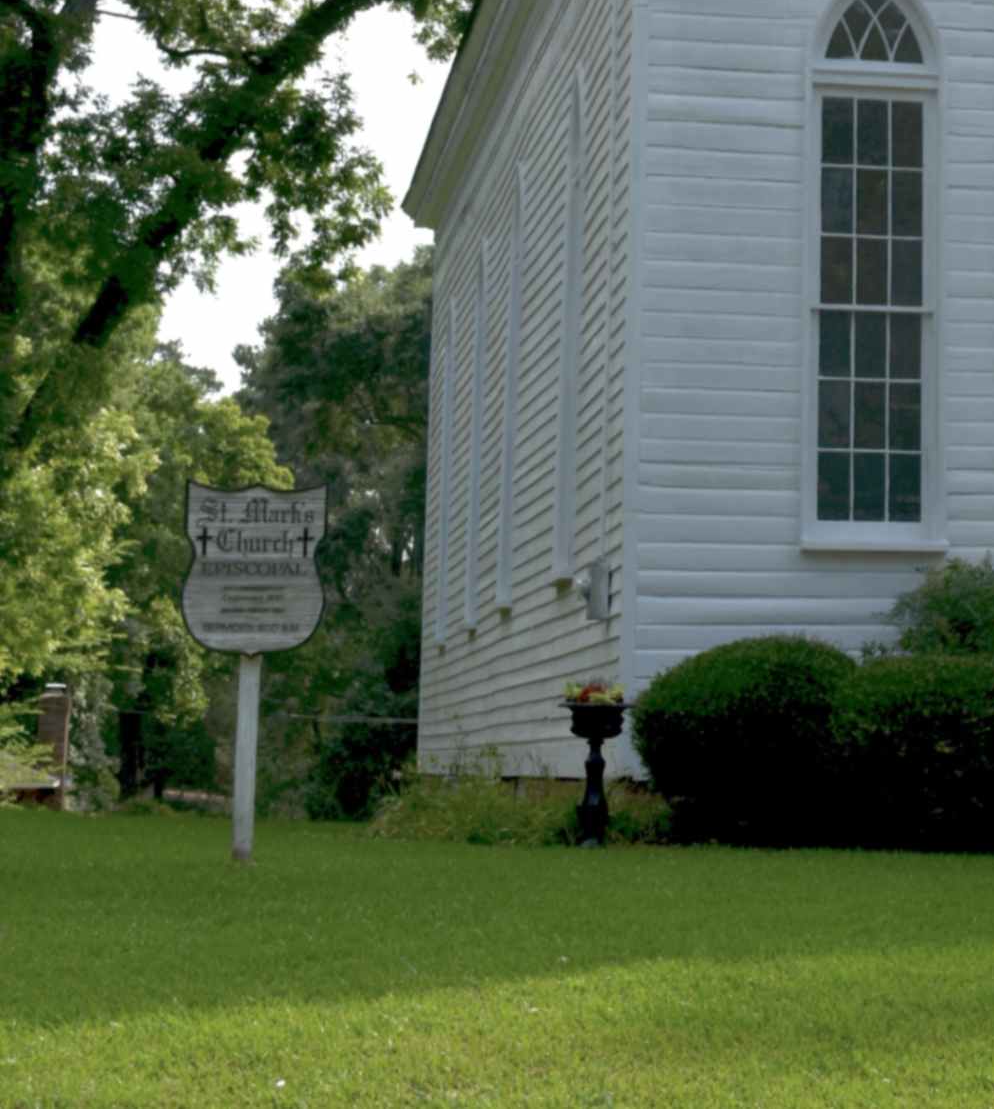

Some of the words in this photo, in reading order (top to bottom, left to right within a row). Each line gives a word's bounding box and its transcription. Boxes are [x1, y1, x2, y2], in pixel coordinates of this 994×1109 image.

[196, 497, 233, 527] St.
[239, 496, 316, 524] Mark's
[216, 527, 294, 559] Church
[202, 561, 307, 577] EPISCOPAL
